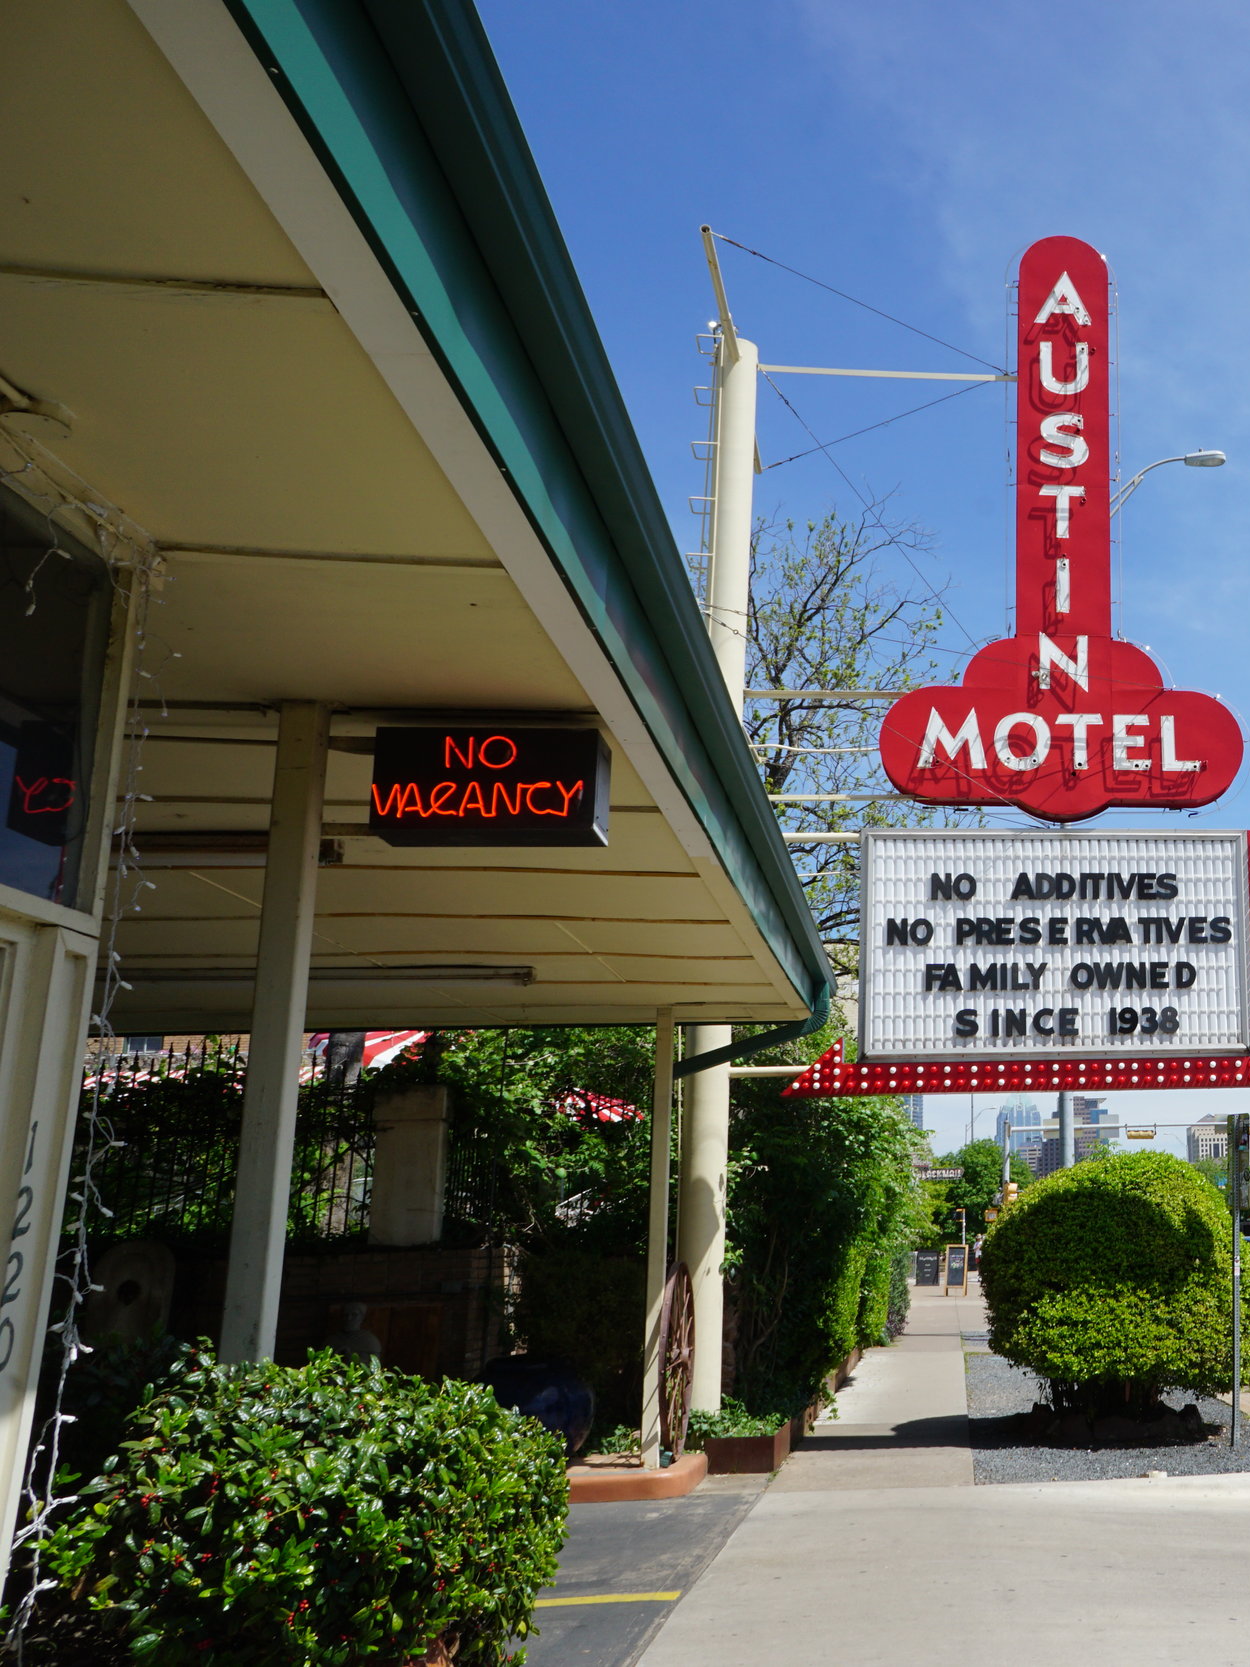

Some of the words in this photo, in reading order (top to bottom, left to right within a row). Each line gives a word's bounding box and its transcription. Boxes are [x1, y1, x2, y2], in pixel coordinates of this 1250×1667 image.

[1033, 271, 1092, 693] AUSTIN
[445, 736, 517, 769] NO
[916, 706, 1209, 773] MOTEL
[372, 780, 584, 818] VACANCY
[931, 872, 977, 901] NO
[1010, 872, 1179, 901] ADDITIVES
[886, 917, 934, 946] NO
[956, 916, 1232, 946] PRESERVATIVES
[925, 962, 1048, 992] FAMILY
[1070, 961, 1197, 990] OWNED
[955, 1008, 1080, 1038] SINCE
[1109, 1006, 1180, 1036] 1938
